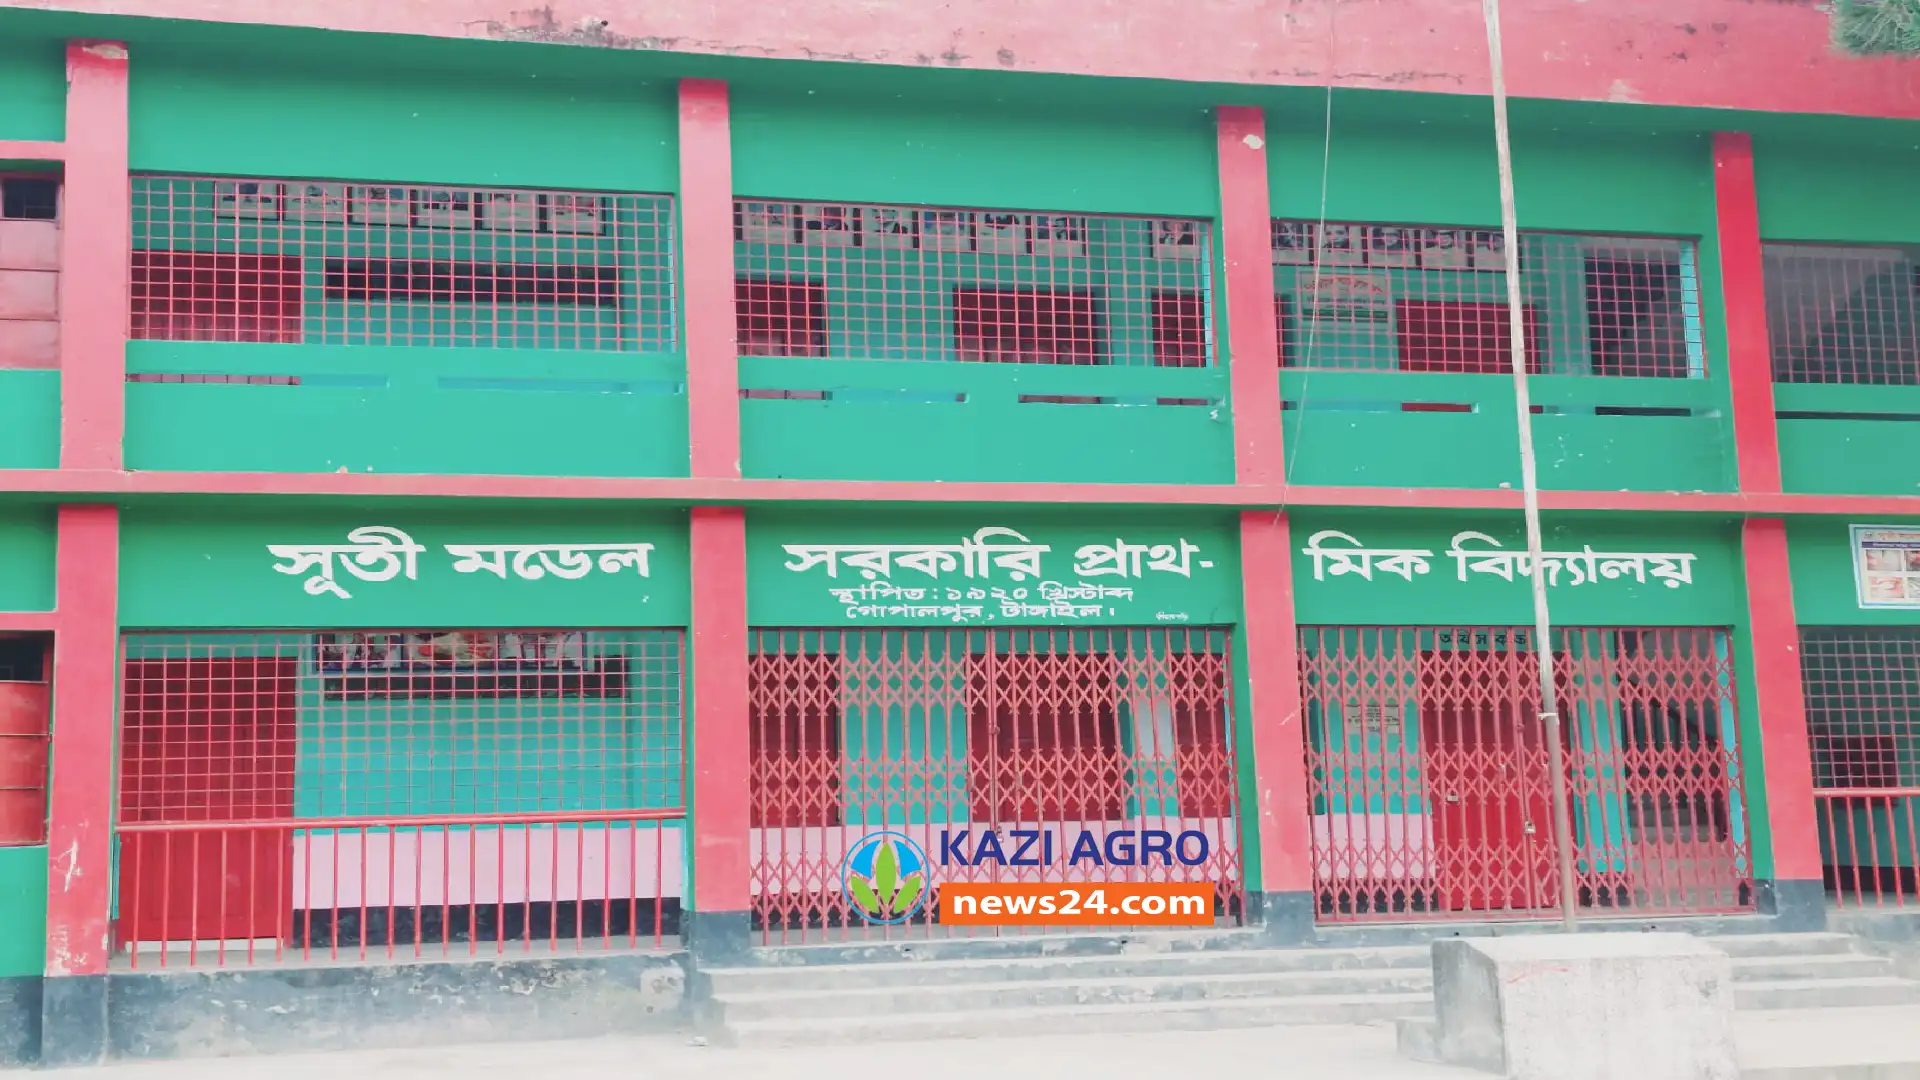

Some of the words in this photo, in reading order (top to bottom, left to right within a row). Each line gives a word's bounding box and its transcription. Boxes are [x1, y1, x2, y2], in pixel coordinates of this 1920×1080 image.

[443, 542, 655, 580] মডেল
[781, 526, 1051, 582] সরকারি
[1073, 537, 1214, 579] প্রাথ-
[1302, 530, 1435, 582] মিক
[1445, 530, 1698, 589] বিদ্যালয়
[944, 585, 1028, 602] ১৯২০
